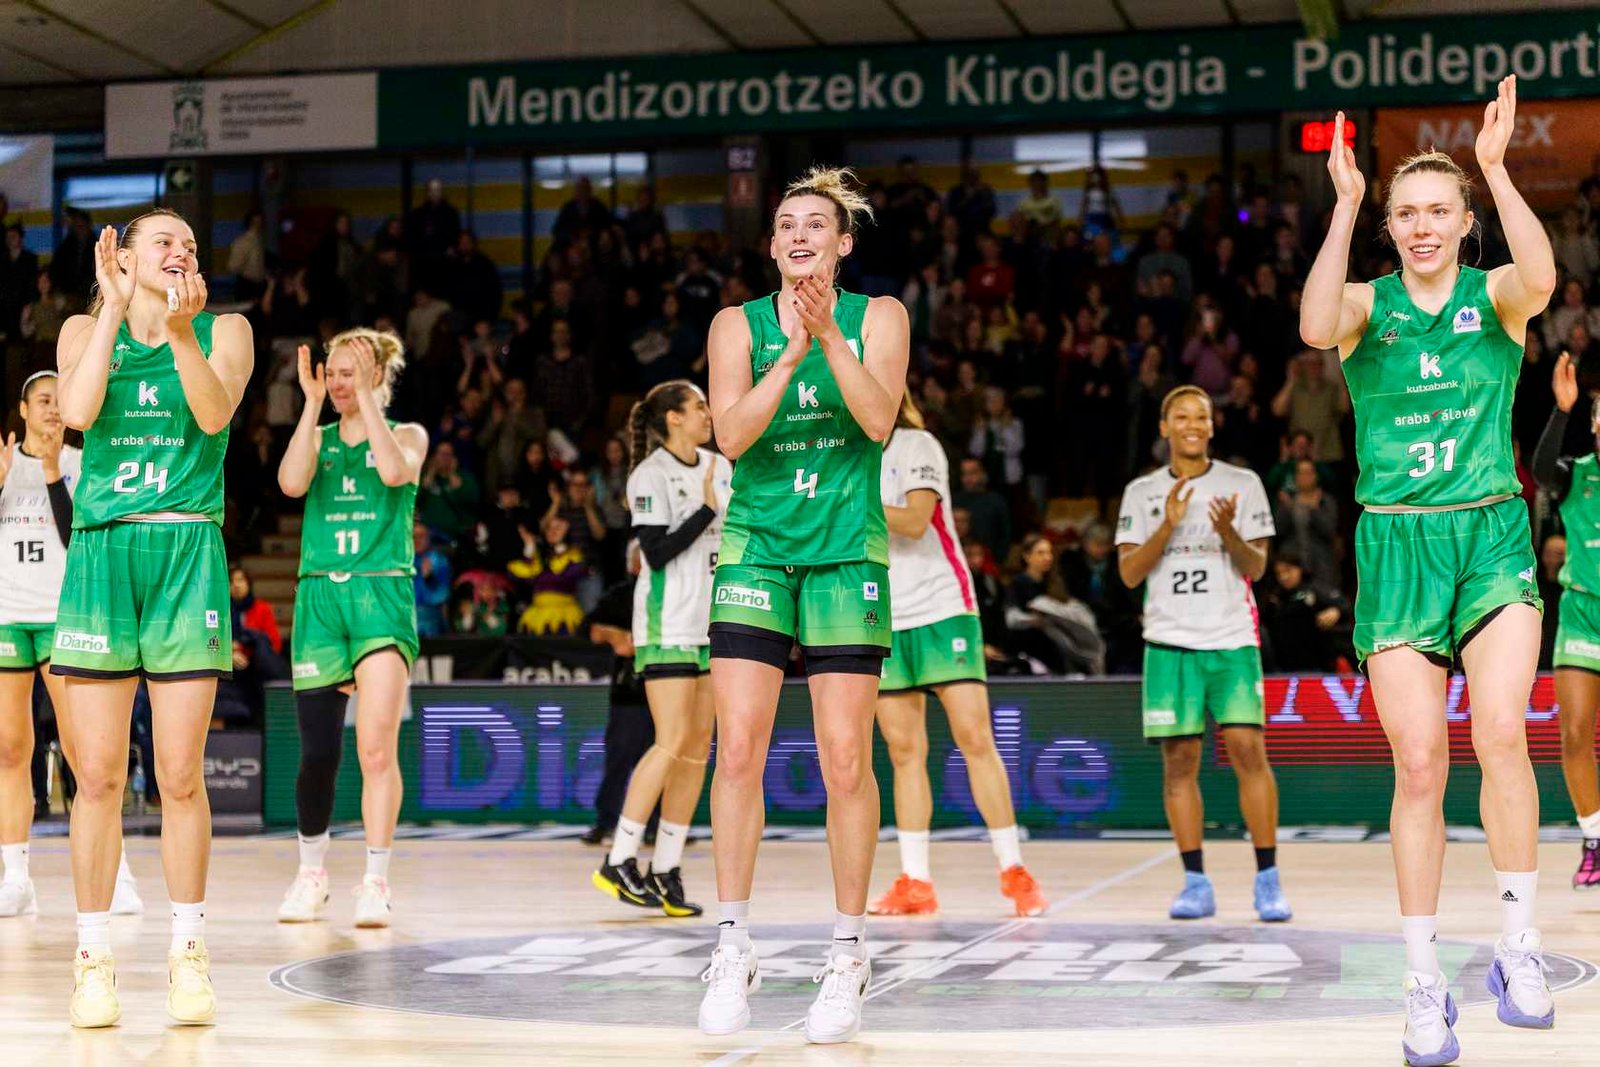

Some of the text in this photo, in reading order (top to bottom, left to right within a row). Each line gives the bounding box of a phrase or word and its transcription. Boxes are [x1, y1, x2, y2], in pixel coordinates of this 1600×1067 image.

[469, 60, 922, 126] Mendizorrotzeko
[946, 46, 1227, 110] Kiroldegia
[1293, 26, 1600, 93] Polideport
[1417, 112, 1558, 148] NAEX
[1406, 380, 1460, 394] kutxabank
[124, 409, 173, 419] kutxabank
[786, 410, 834, 423] kutxabank
[1394, 405, 1478, 427] araba álava
[110, 434, 186, 447] araba álava
[773, 439, 807, 453] araba
[1407, 437, 1458, 479] 31
[112, 460, 170, 495] 24
[793, 468, 819, 499] 4
[14, 540, 45, 563] 15
[334, 529, 360, 556] 11
[1172, 570, 1209, 595] 22
[717, 587, 765, 608] Diario
[60, 633, 104, 651] Diario
